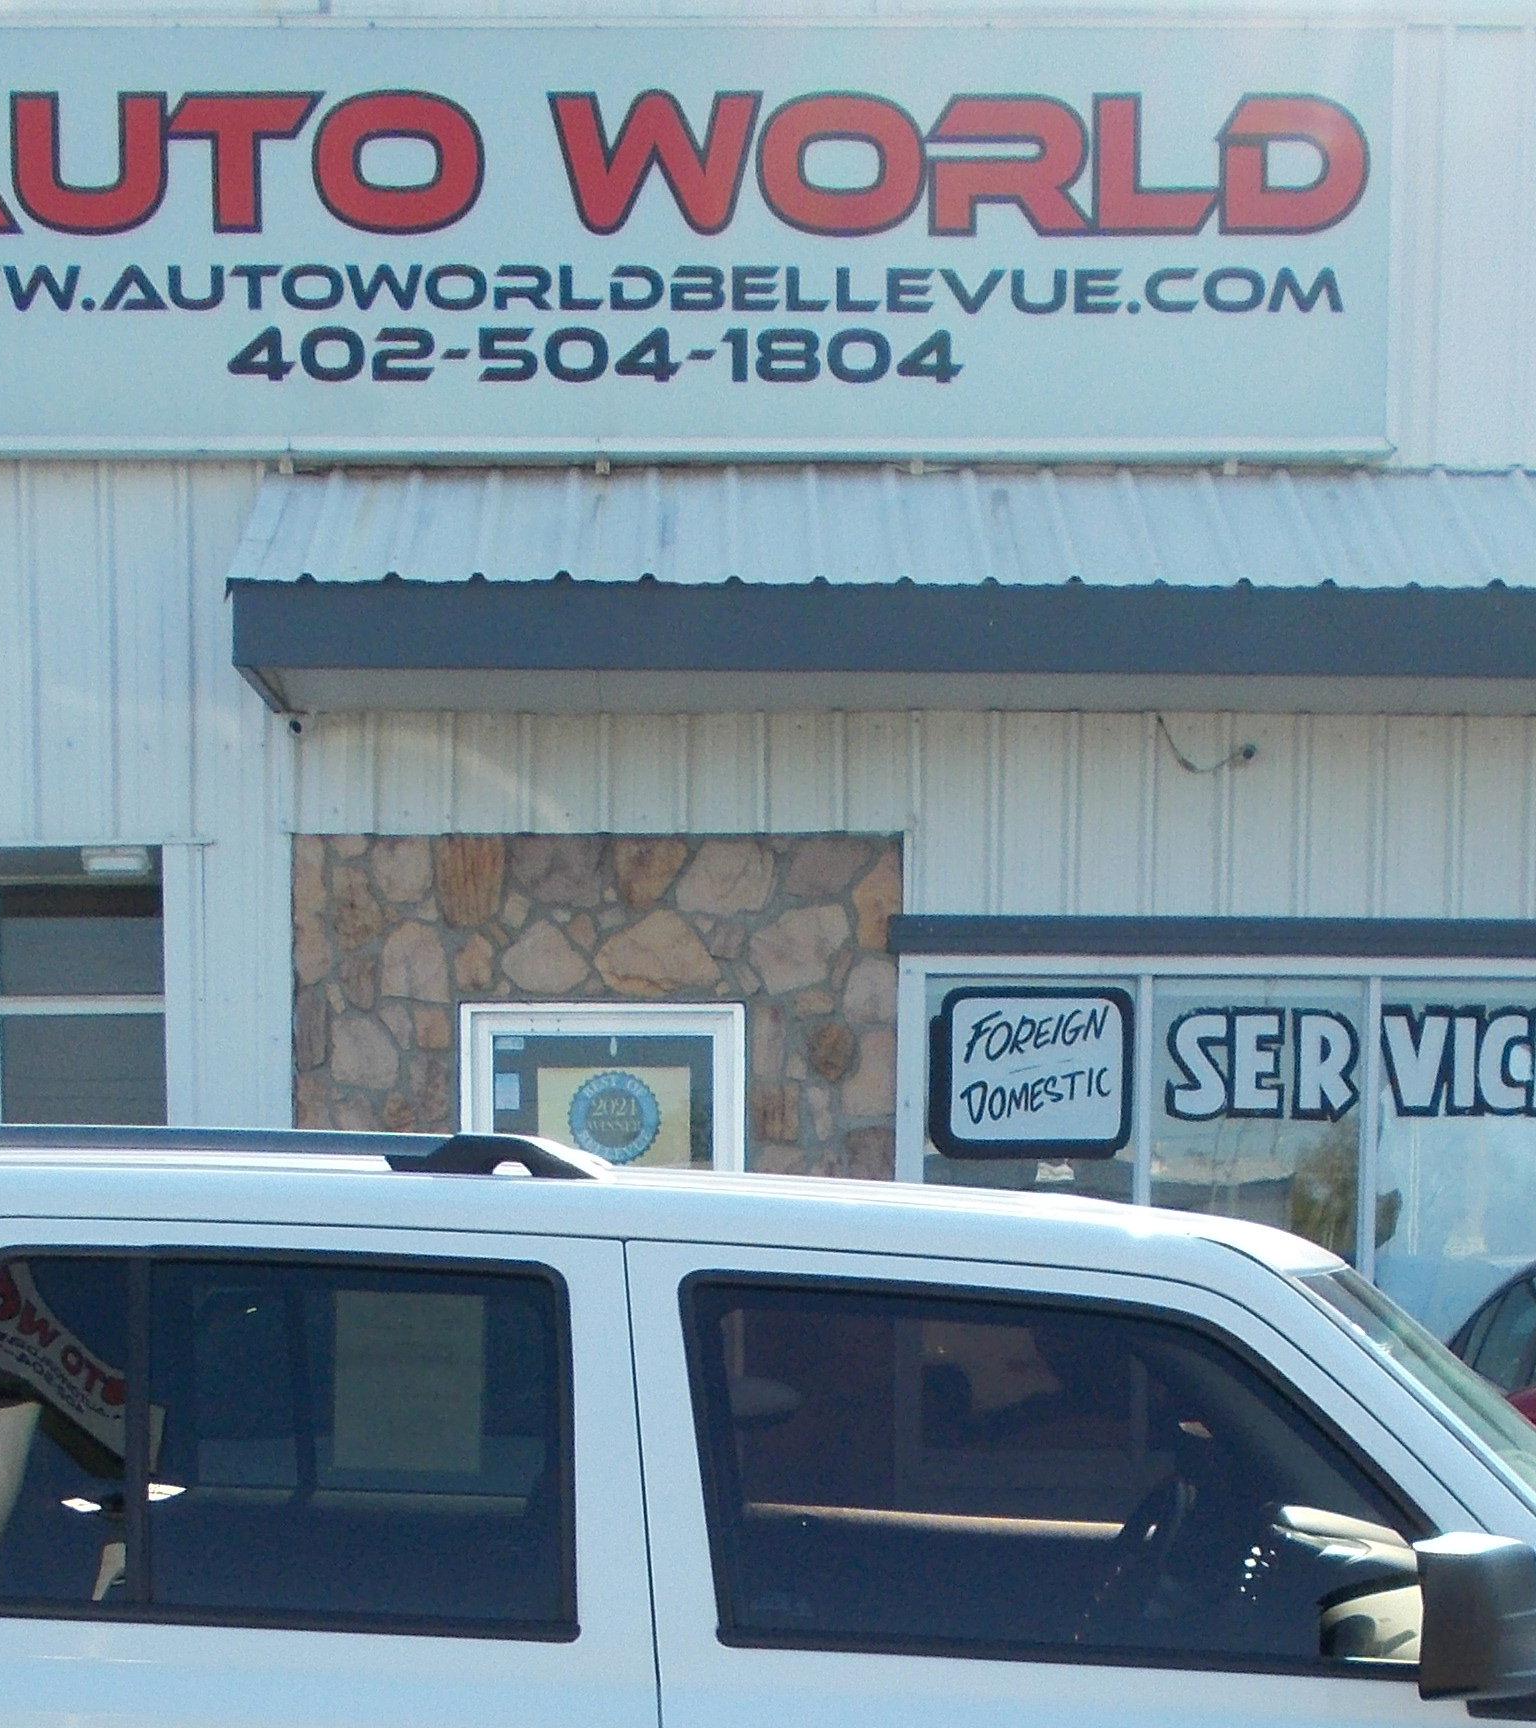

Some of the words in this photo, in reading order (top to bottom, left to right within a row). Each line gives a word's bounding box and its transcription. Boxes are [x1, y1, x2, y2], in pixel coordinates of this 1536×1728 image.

[547, 88, 1370, 238] WORLD
[227, 325, 964, 384] 402-504-1804
[963, 1004, 1110, 1064] FOREIGN
[591, 1097, 637, 1116] 2021
[959, 1066, 1112, 1125] DOMESTIC
[586, 1119, 642, 1133] WINNER
